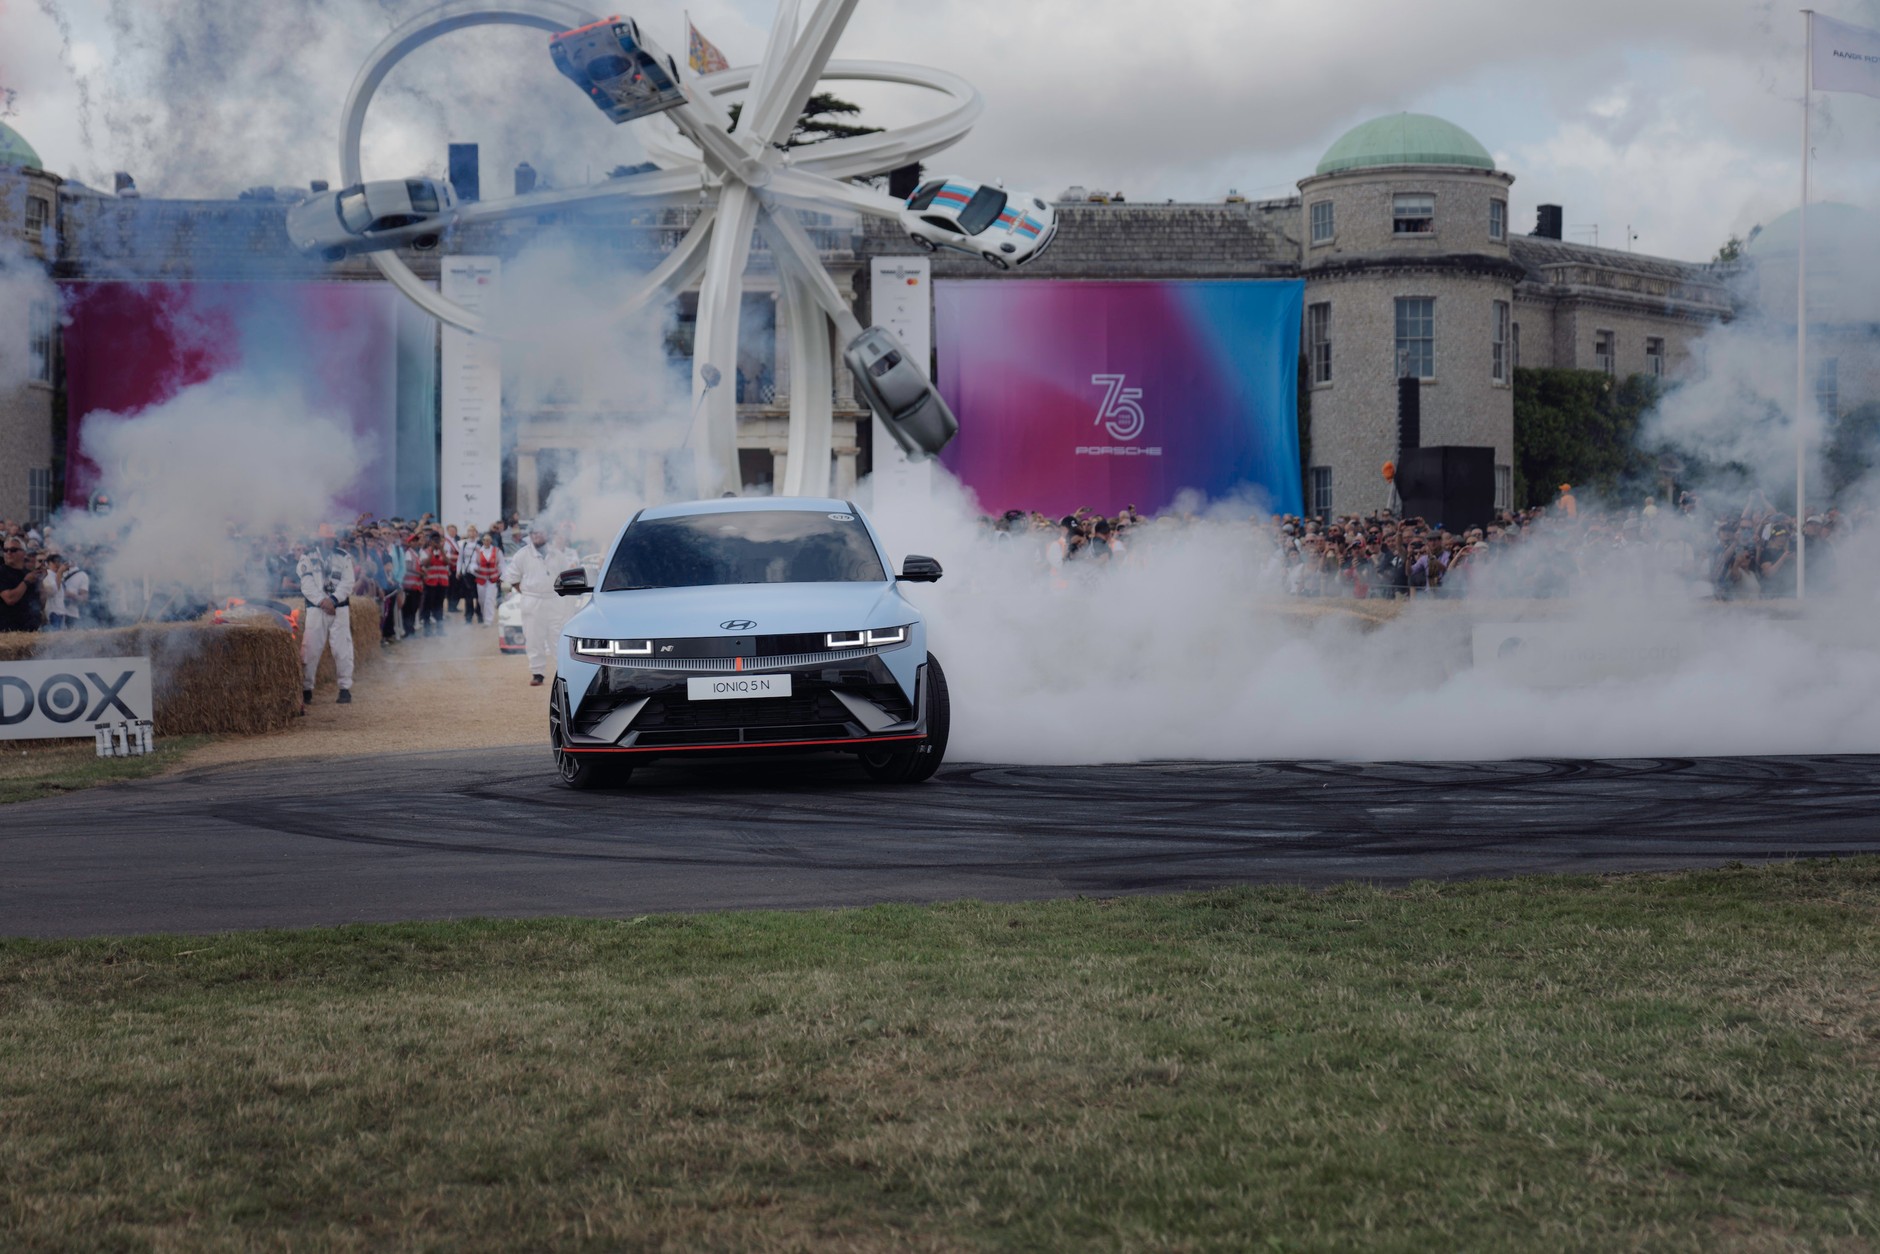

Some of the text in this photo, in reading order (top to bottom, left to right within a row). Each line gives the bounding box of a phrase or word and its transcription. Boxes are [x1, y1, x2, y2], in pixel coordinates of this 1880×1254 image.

[1091, 374, 1144, 440] 75
[1075, 446, 1162, 455] PORSCHE
[713, 680, 769, 693] IONIQ 5 N
